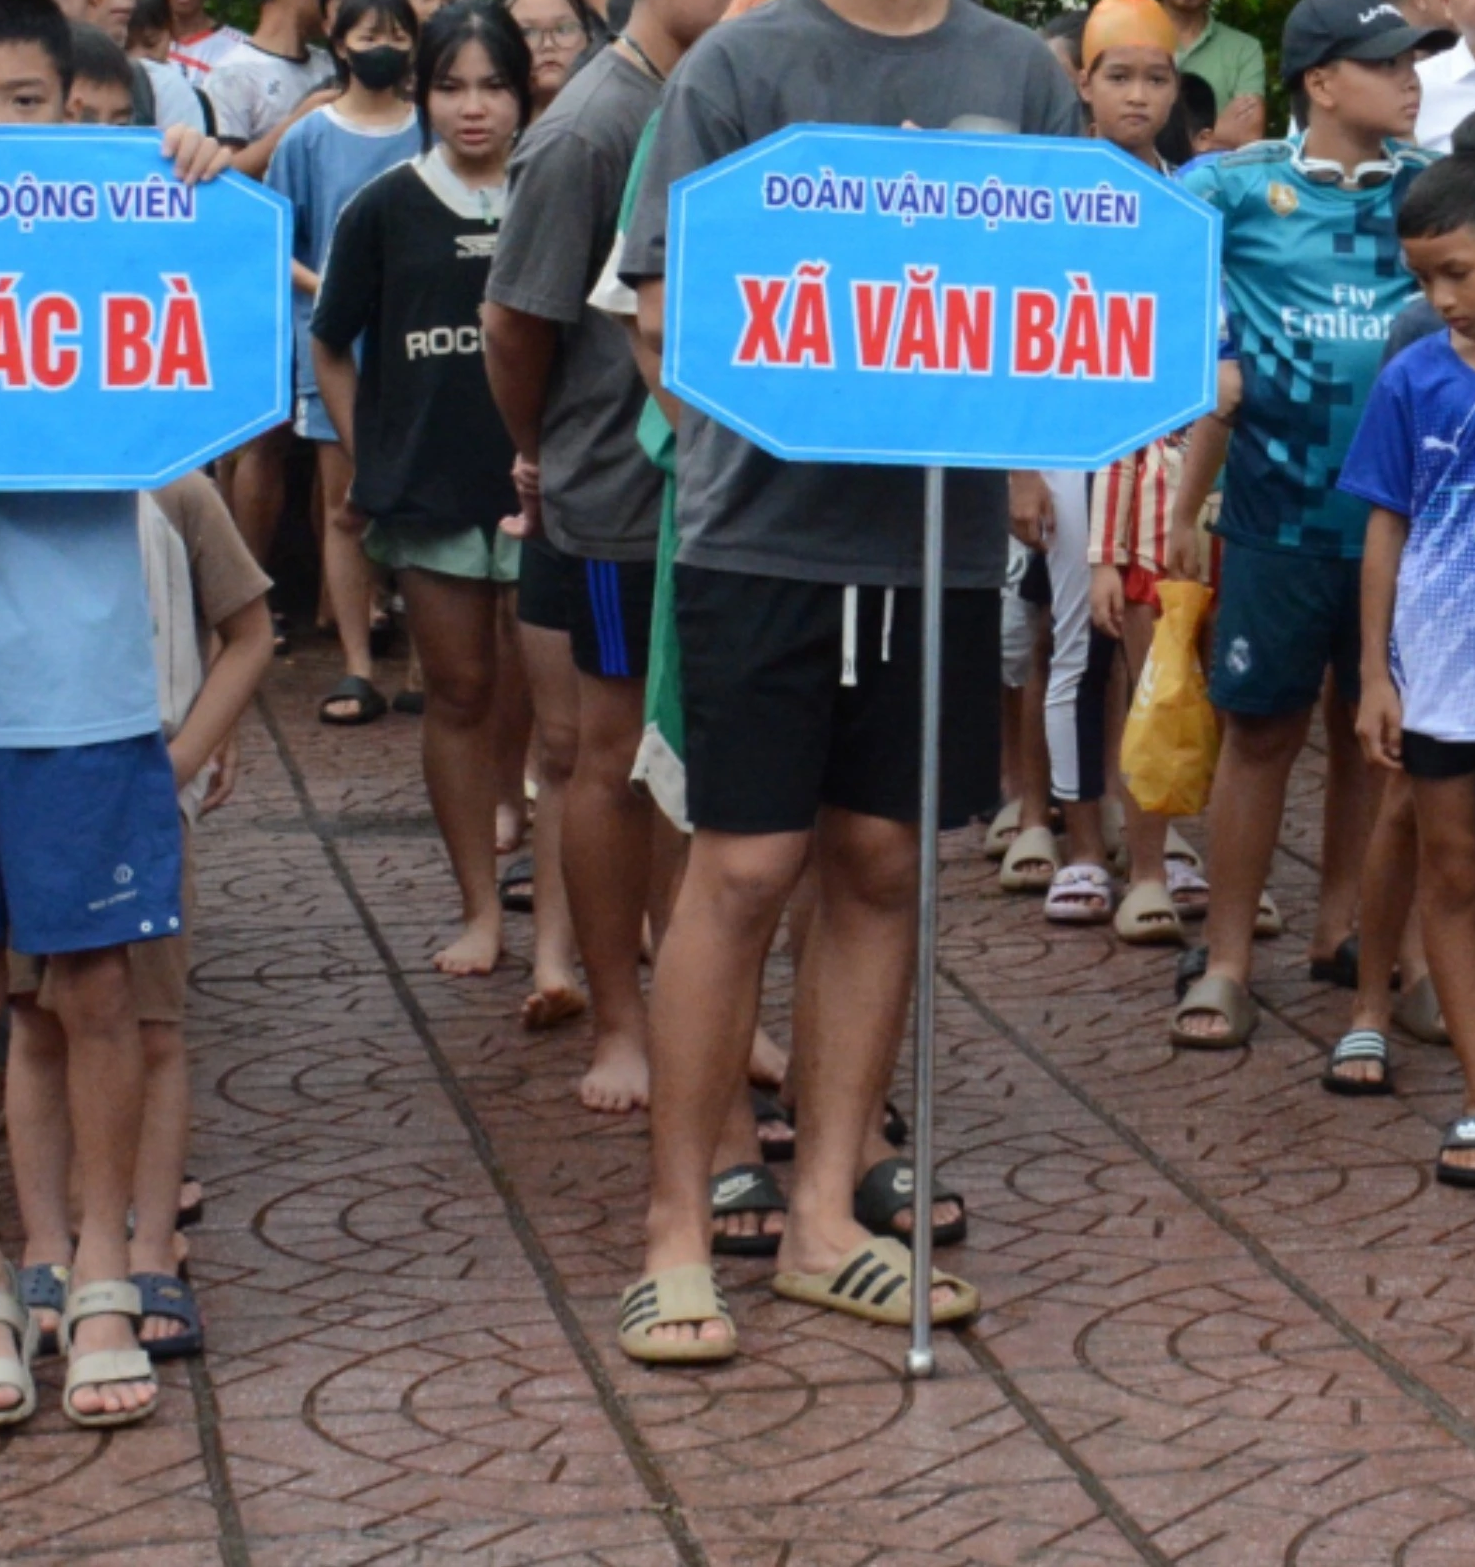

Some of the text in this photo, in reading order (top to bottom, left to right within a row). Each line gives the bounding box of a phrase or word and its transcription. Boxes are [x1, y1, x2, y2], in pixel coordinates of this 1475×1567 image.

[107, 175, 196, 222] VIÊN
[764, 168, 1138, 232] ĐOÀN VẬN ĐỘNG VIÊN
[734, 262, 1156, 381] XÃ VĂN BÀN
[1332, 283, 1377, 310] Fly
[101, 274, 211, 390] BÀ
